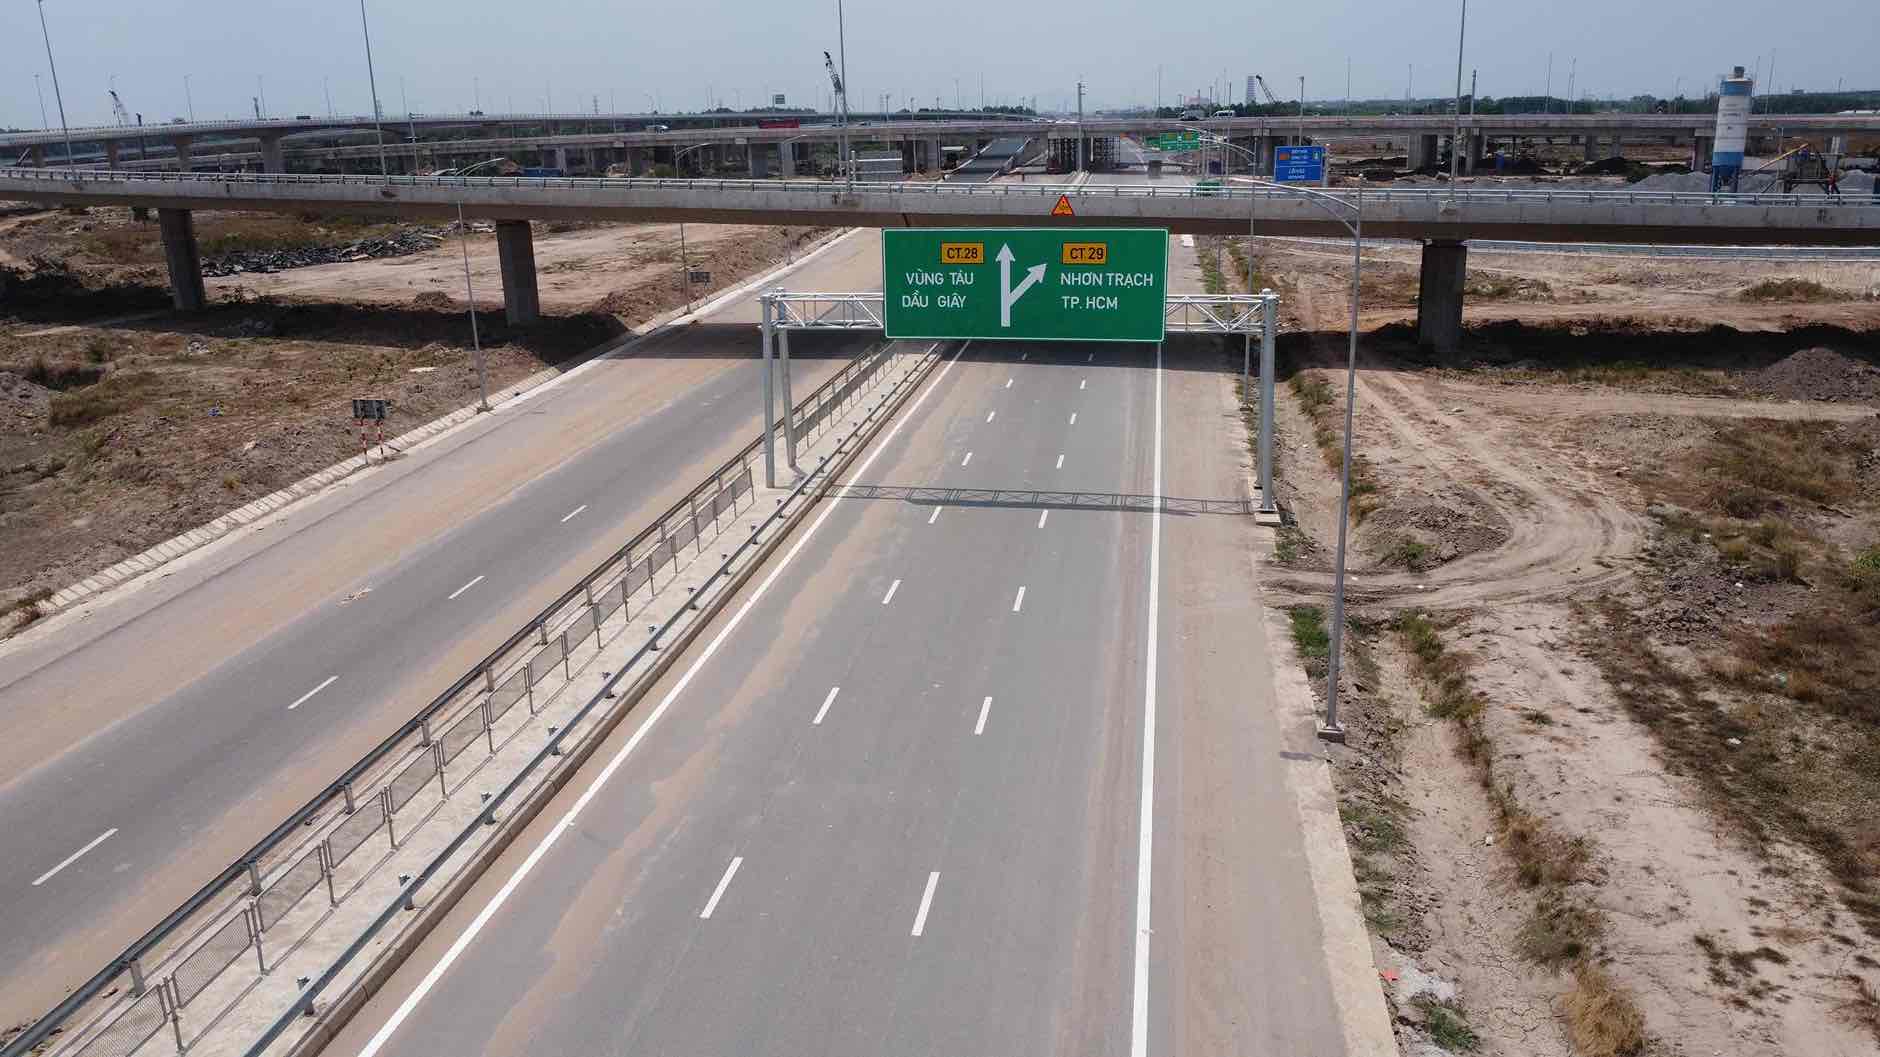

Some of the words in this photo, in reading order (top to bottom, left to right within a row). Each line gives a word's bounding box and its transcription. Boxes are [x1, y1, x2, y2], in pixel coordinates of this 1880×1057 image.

[947, 247, 978, 260] CT.28
[949, 269, 975, 285] TÀU
[1060, 271, 1103, 286] NHƠN
[1105, 272, 1153, 289] TRẠCH
[902, 290, 929, 308] DẦU
[937, 292, 967, 309] GIÂY
[1061, 296, 1083, 310] TP.
[1085, 296, 1118, 310] HCM
